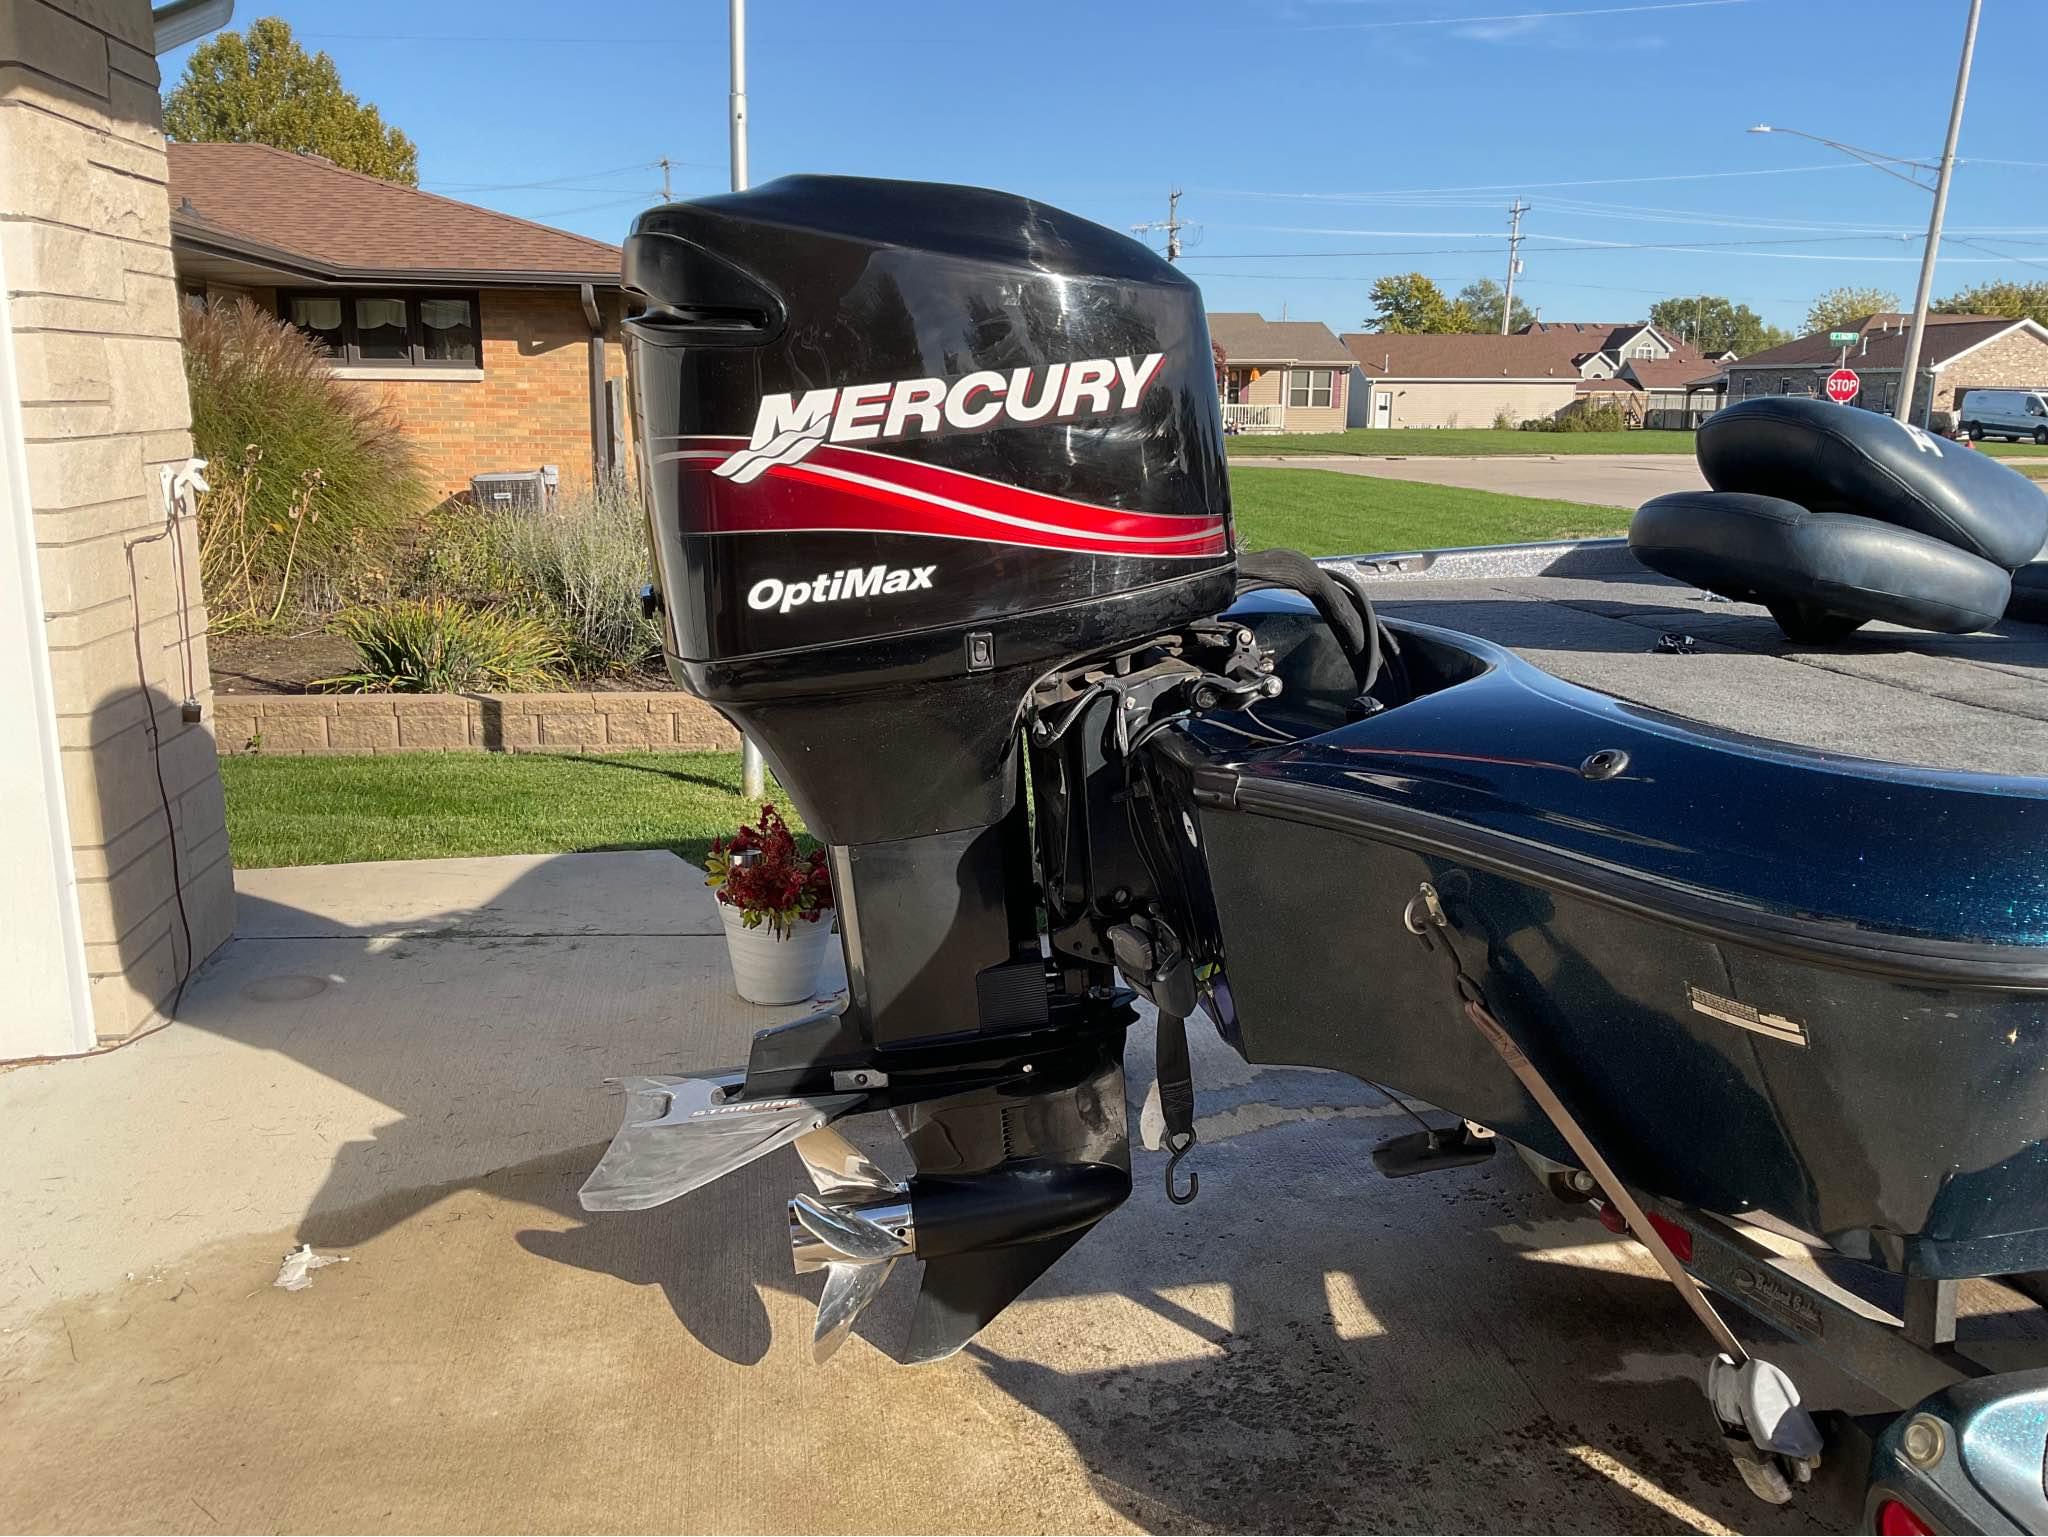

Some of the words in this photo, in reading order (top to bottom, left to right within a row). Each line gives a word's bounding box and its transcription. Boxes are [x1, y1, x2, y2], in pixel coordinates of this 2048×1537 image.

[744, 353, 1166, 451] MERCURY
[1828, 378, 1857, 392] STOP
[746, 564, 937, 614] OptiMax
